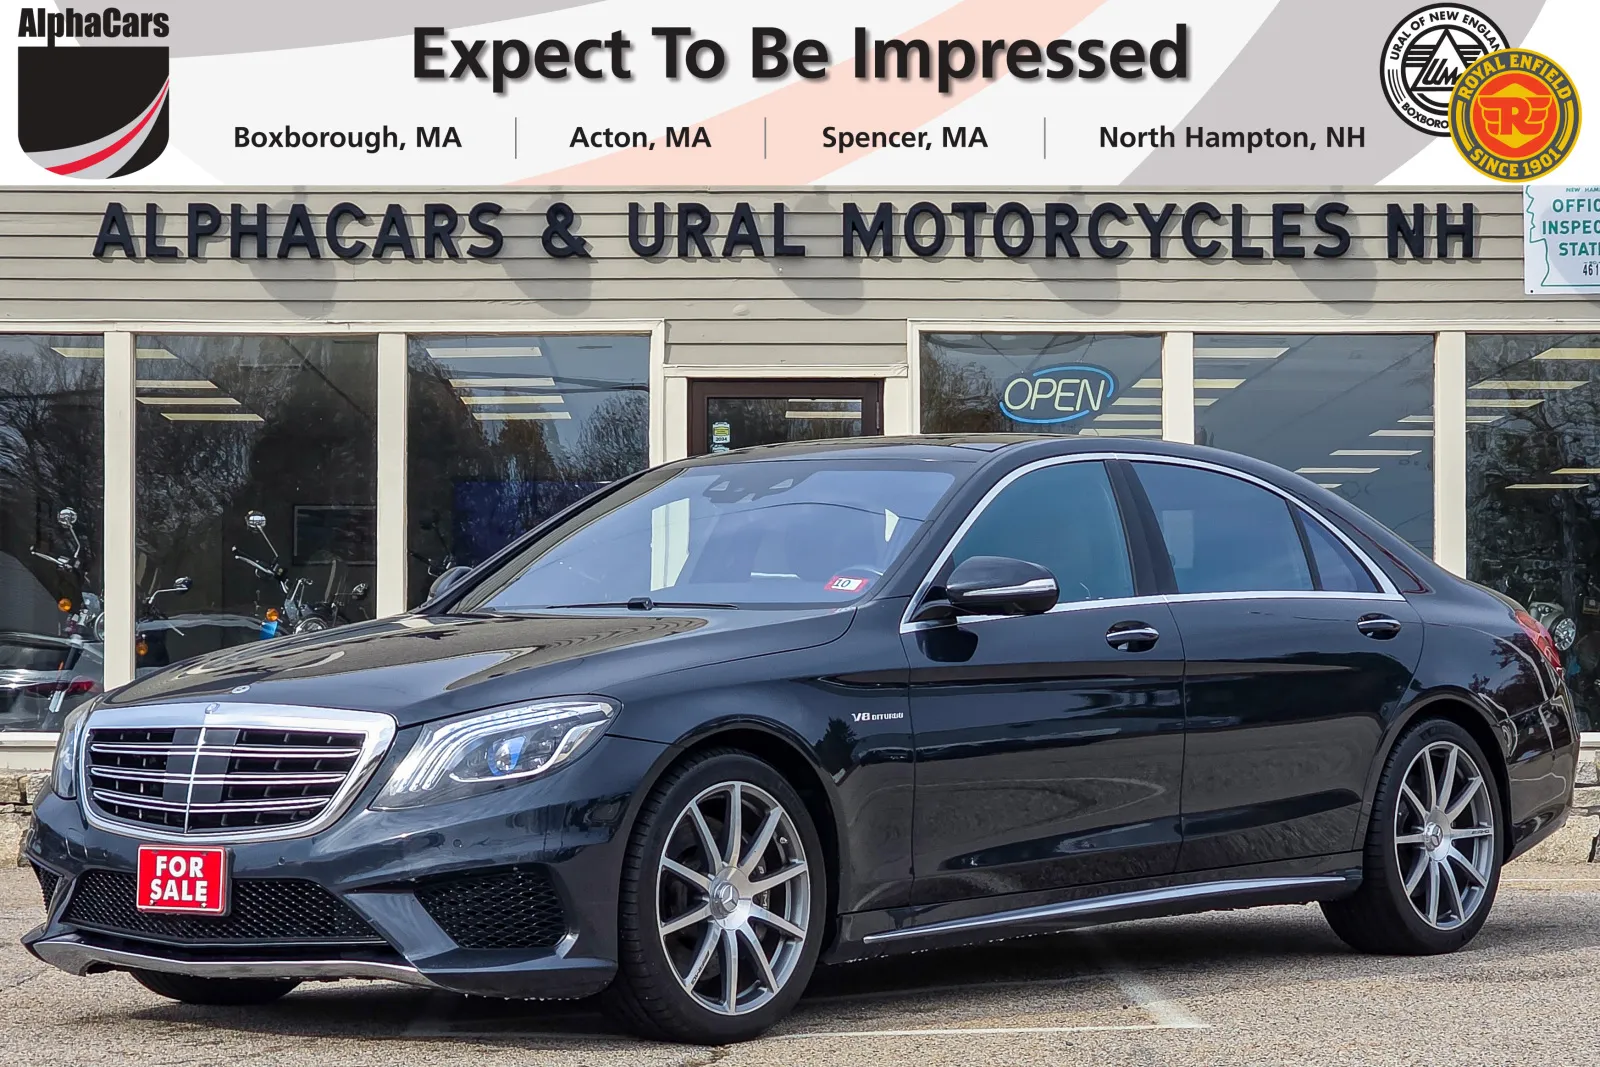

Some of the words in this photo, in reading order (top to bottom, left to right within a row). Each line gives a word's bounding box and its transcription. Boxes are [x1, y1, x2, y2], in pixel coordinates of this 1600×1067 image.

[93, 202, 504, 259] ALPHACARS
[541, 202, 593, 259] &
[628, 202, 806, 258] URAL
[842, 201, 1350, 259] MOTORCYCLES
[1386, 202, 1474, 259] NH
[1003, 377, 1106, 412] OPEN
[833, 579, 852, 588] 10
[851, 712, 871, 722] V8
[155, 855, 204, 878] FOR
[149, 878, 208, 902] SALE
